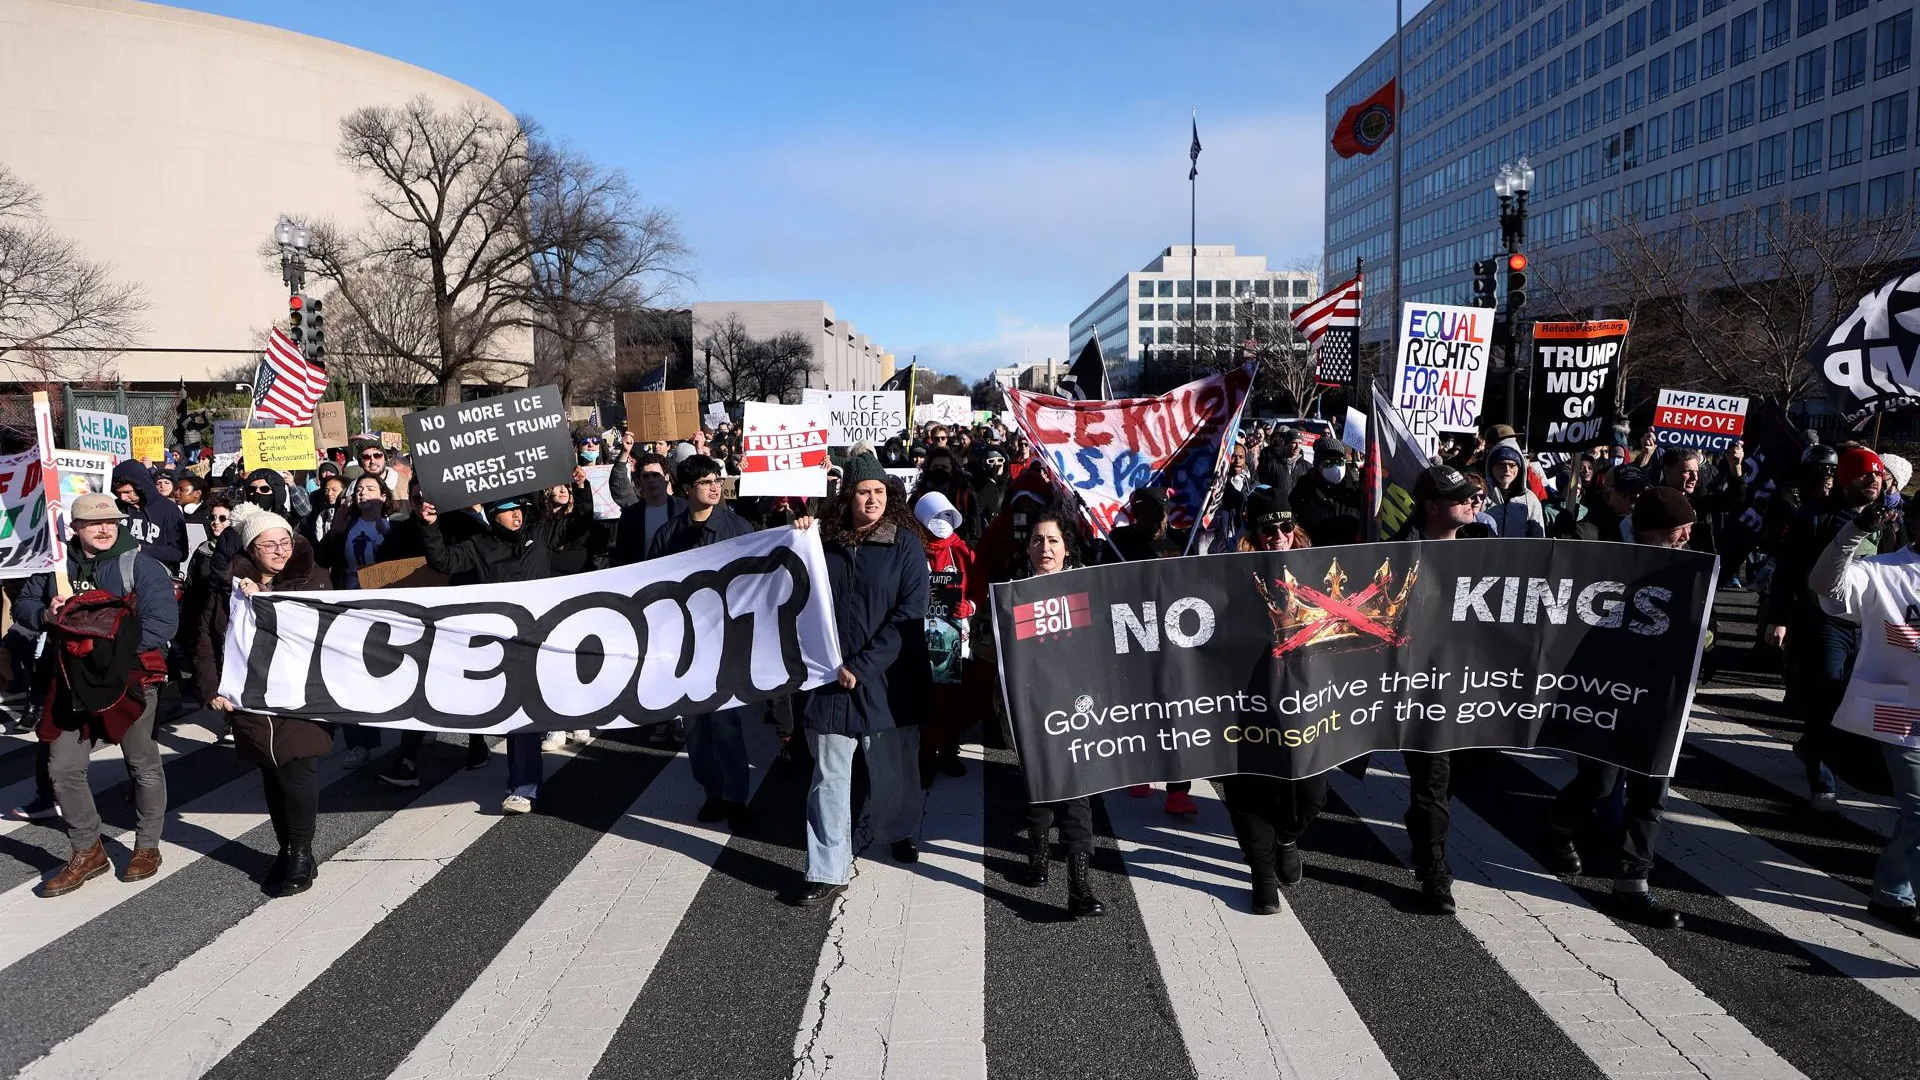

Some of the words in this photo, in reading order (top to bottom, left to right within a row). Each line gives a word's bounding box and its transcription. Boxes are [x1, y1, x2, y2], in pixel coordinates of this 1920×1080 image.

[1409, 310, 1484, 343] EQUAL
[1406, 338, 1483, 371] RIGHTS
[1539, 342, 1618, 368] TRUMP
[1402, 366, 1439, 395] FOR
[1439, 371, 1477, 398] ALL
[1546, 367, 1609, 394] MUST
[420, 415, 445, 431] NO
[458, 403, 504, 424] MORE
[514, 395, 543, 413] ICE
[853, 395, 885, 410] ICE
[1563, 395, 1595, 418] GO
[1666, 393, 1739, 412] IMPEACH
[79, 415, 100, 435] WE
[103, 417, 128, 440] HAD
[831, 411, 902, 427] MURDERS
[1396, 409, 1440, 436] VER
[1546, 417, 1603, 444] NOW!
[1662, 411, 1736, 431] REMOVE
[82, 435, 126, 455] WHISTLES
[257, 431, 308, 441] Incompetents
[258, 442, 286, 452] Cretins
[415, 439, 440, 456] NO
[450, 427, 499, 450] MORE
[506, 413, 561, 436] TRUMP
[750, 431, 824, 450] FUERA
[843, 427, 888, 443] MOMS
[1658, 430, 1733, 450] CONVICT
[56, 457, 105, 470] CRUSH
[442, 455, 506, 483] ARREST
[515, 445, 549, 465] THE
[767, 453, 803, 471] ICE
[465, 466, 536, 494] RACISTS
[119, 518, 160, 543] AP
[928, 605, 949, 616] OOD
[1033, 597, 1060, 618] 50
[1110, 597, 1216, 654] NO
[1451, 576, 1673, 636] KINGS
[264, 598, 520, 716] ICE
[535, 564, 795, 718] OUT
[1044, 690, 1268, 735] Governments
[1279, 679, 1367, 715] derive
[1379, 667, 1451, 693] their
[1460, 666, 1524, 694] just
[1535, 672, 1649, 704] power
[1068, 734, 1146, 763] from
[1157, 727, 1211, 751] the
[1223, 710, 1341, 747] consent
[1350, 701, 1384, 725] of
[1394, 698, 1446, 721] the
[1456, 700, 1619, 731] governed
